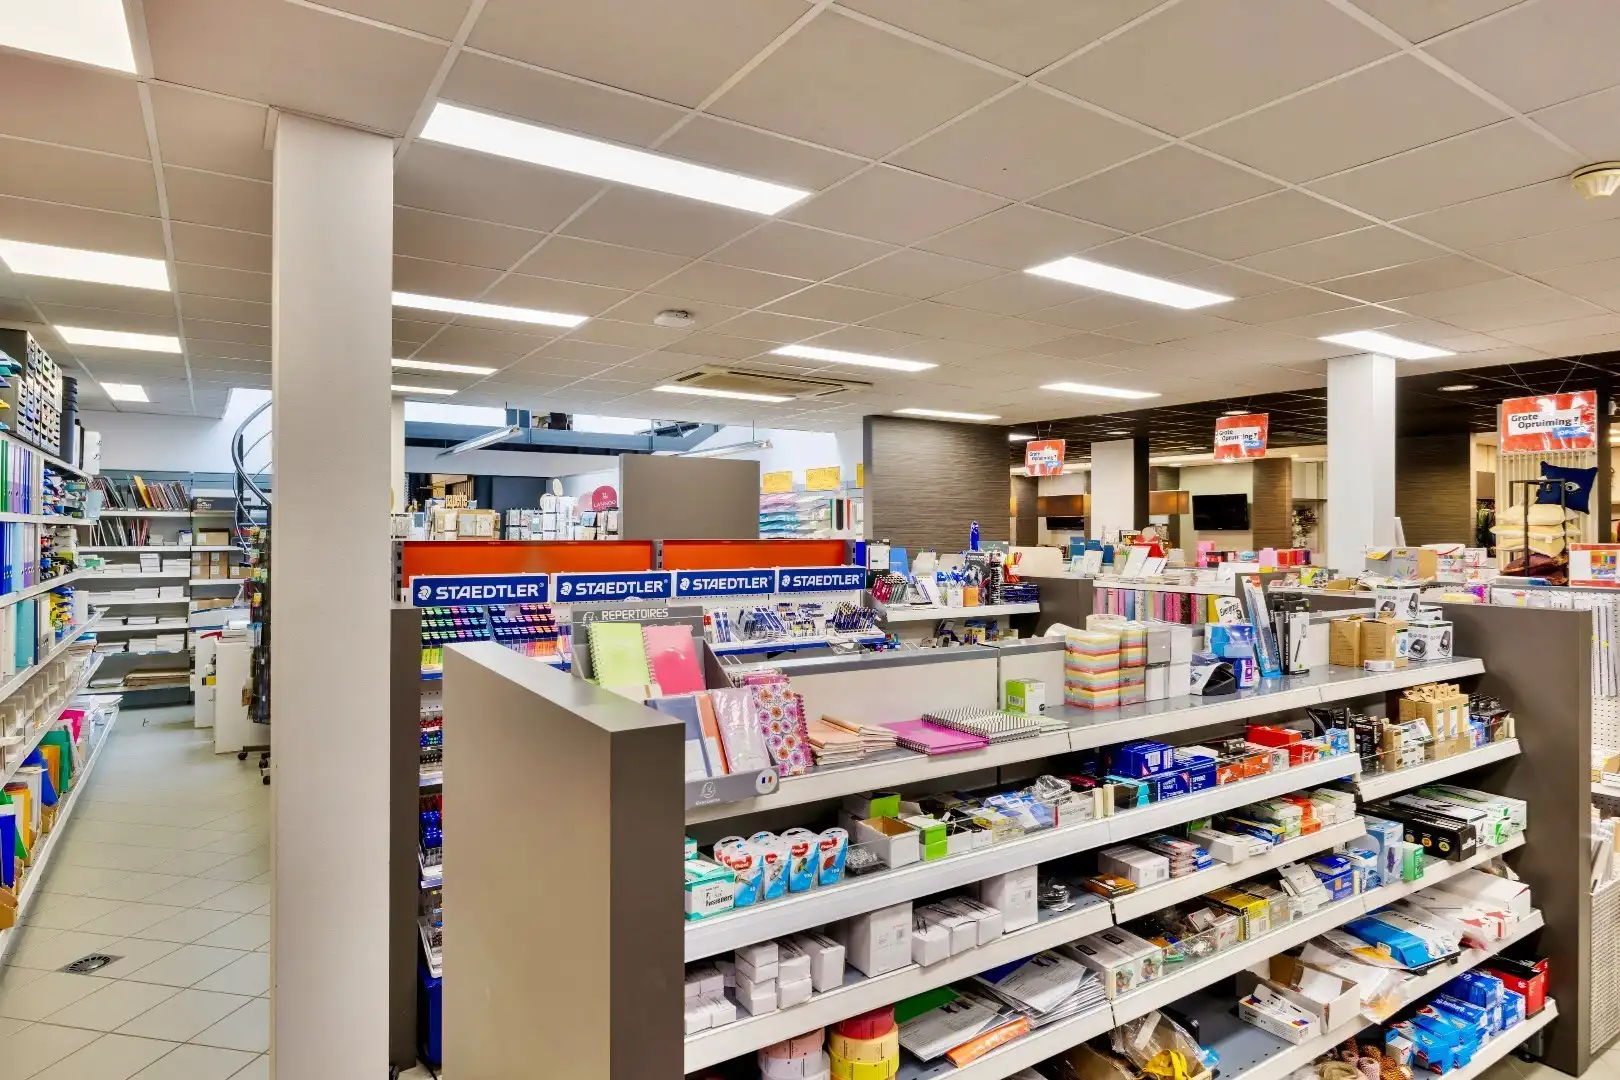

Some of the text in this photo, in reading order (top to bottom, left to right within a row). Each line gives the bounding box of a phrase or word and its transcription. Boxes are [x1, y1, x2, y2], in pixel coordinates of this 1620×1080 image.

[575, 580, 663, 596] STAEDTLER
[693, 576, 768, 591] STAEDTLER
[793, 574, 860, 587] STAEDTLER
[435, 584, 539, 600] STAEDTLER
[601, 607, 669, 620] REPERTOIRES
